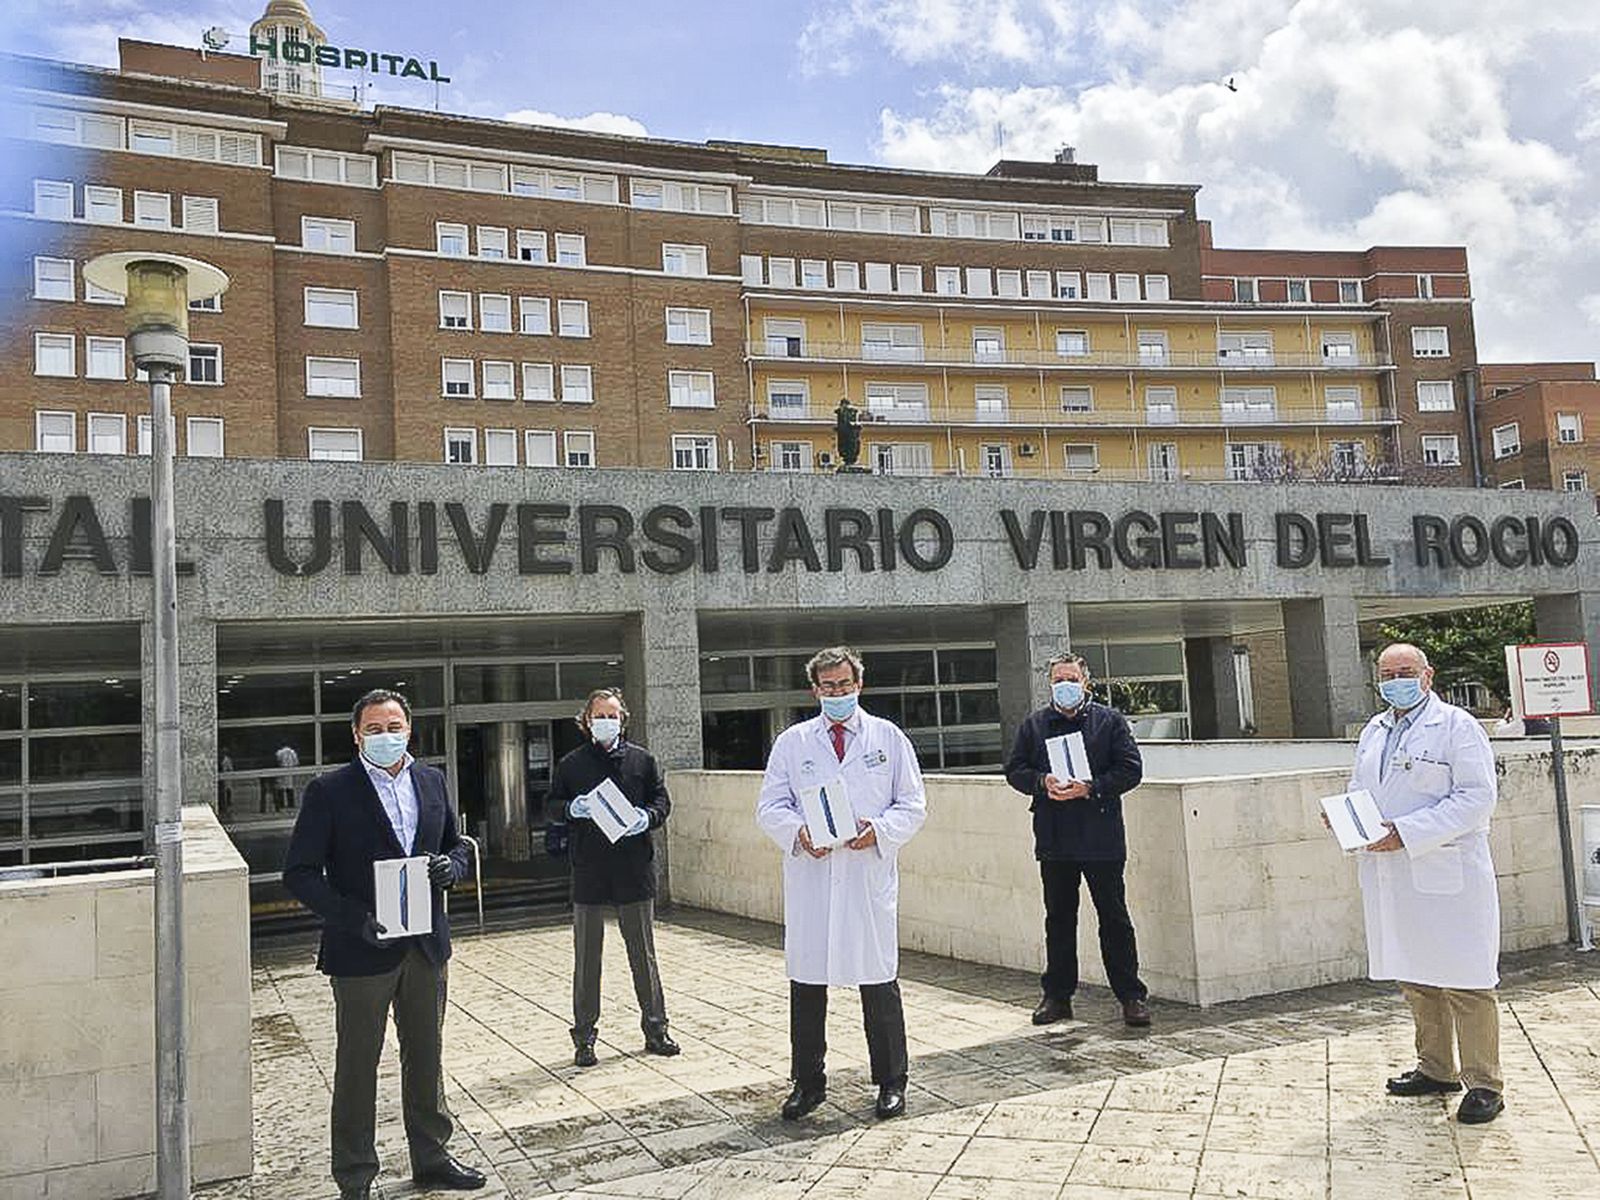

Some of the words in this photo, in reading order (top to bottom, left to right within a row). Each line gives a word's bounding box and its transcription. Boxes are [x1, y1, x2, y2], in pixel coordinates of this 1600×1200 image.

[250, 34, 450, 83] HOSPITAL
[264, 499, 953, 576] UNIVERSITARIO
[1001, 509, 1248, 570] VIRGEN
[1275, 511, 1391, 569] DEL
[1412, 514, 1579, 568] ROCIO
